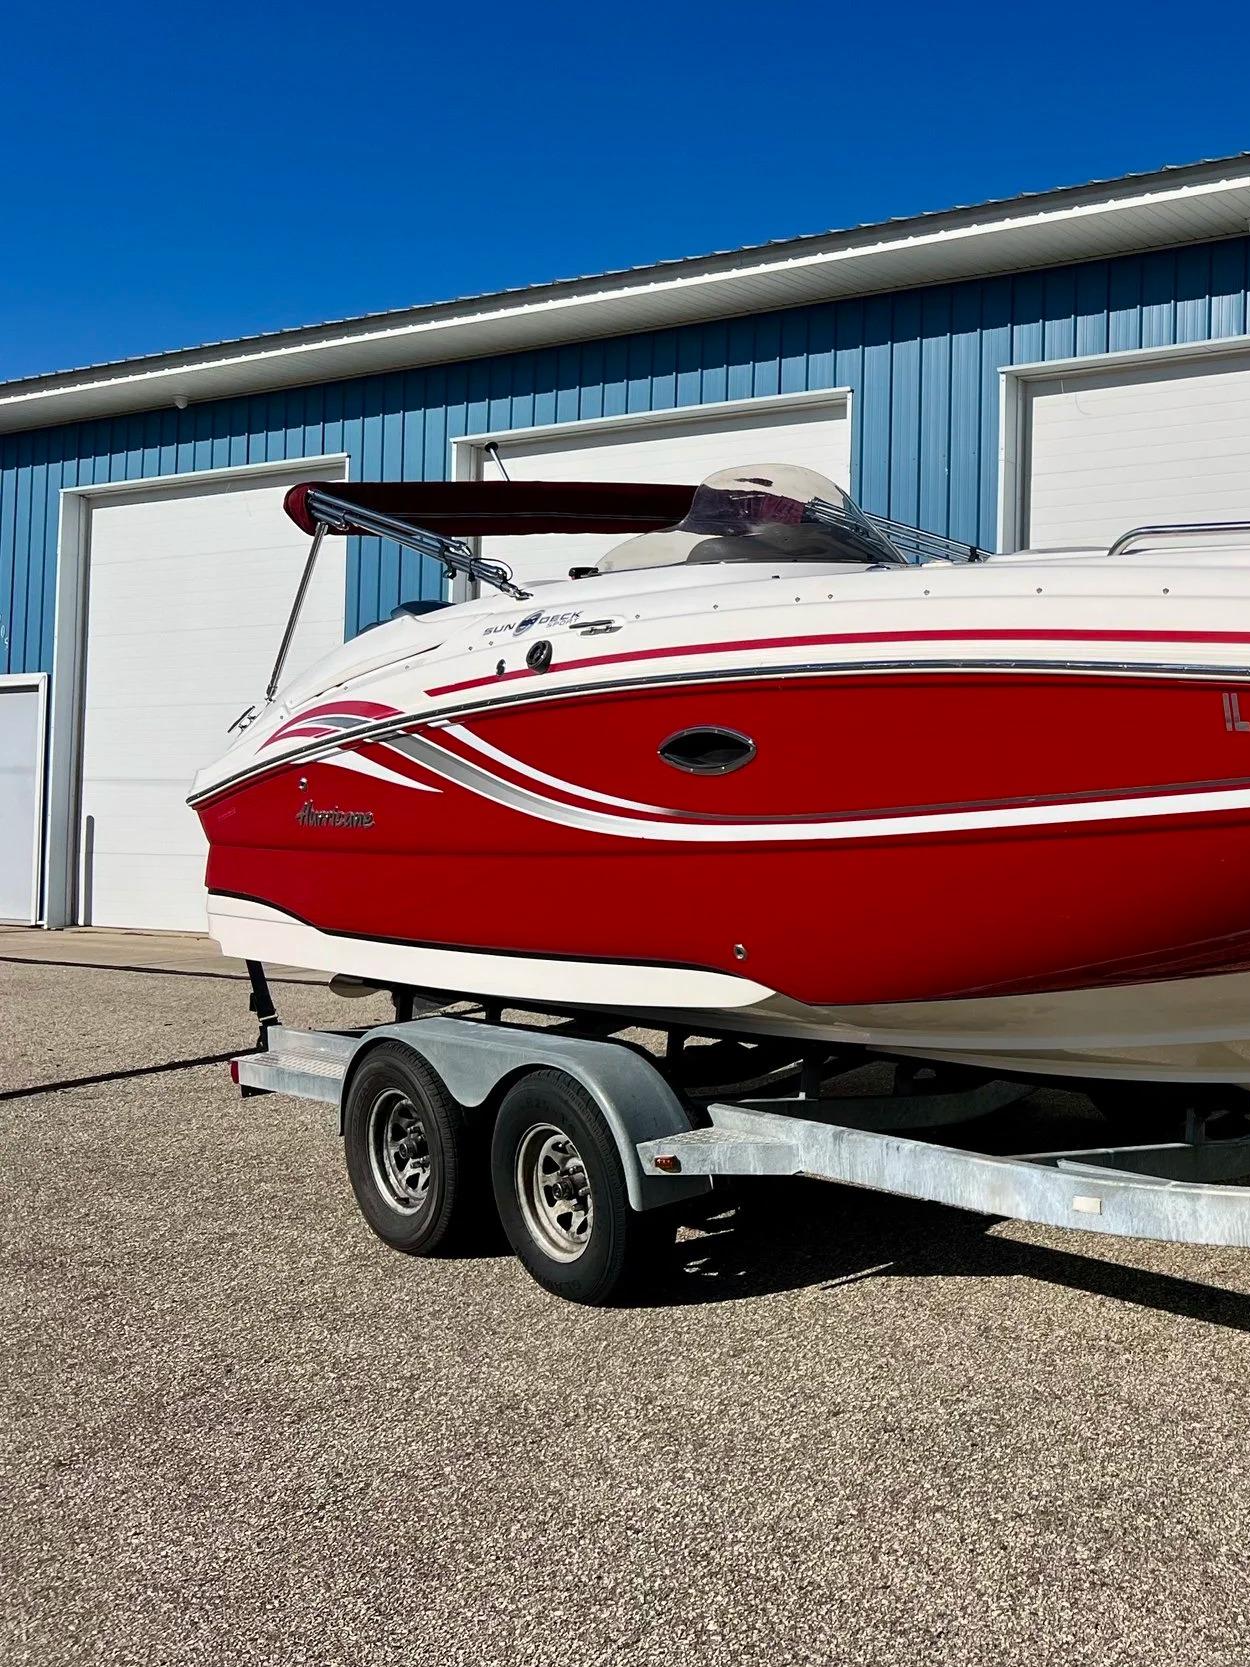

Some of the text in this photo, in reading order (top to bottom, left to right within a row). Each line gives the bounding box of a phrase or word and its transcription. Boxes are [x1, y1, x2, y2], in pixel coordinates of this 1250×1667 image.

[483, 610, 584, 636] SUN DECK
[1222, 693, 1250, 732] IL
[295, 799, 376, 828] Hurricane
